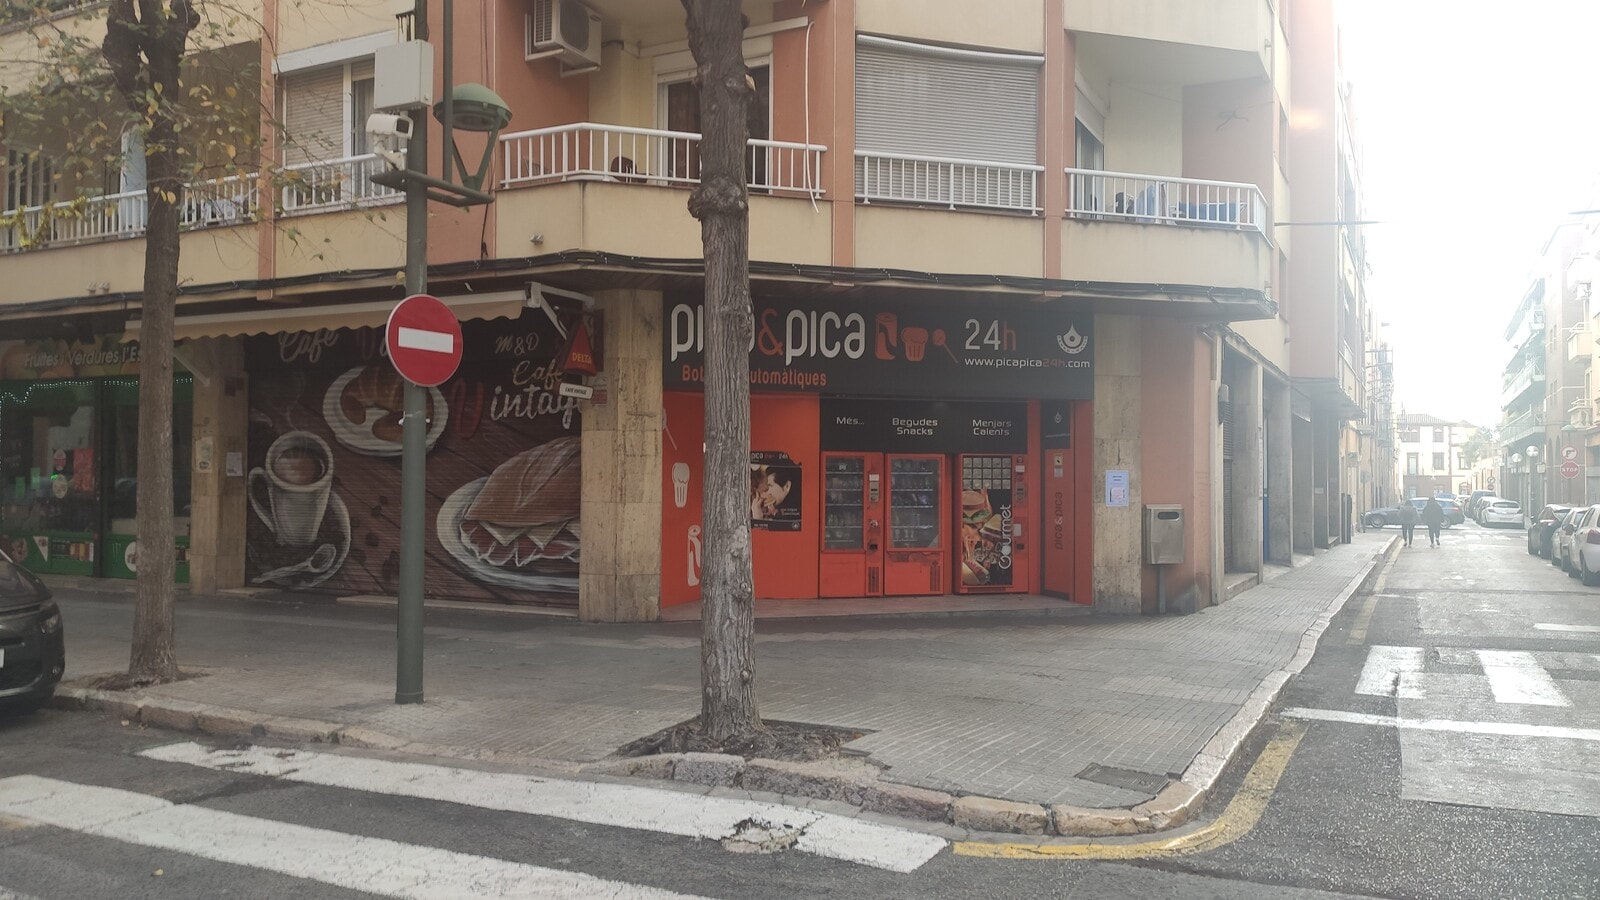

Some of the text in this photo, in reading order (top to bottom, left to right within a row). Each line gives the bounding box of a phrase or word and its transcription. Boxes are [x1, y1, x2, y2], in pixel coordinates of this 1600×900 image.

[671, 304, 866, 366] pi&pica
[965, 319, 1016, 350] 24h
[24, 352, 58, 367] Fruites
[68, 350, 119, 365] Verdures
[572, 352, 592, 364] DELTA
[965, 357, 1090, 369] www.picapica24h.com
[749, 368, 827, 389] utomàtiques
[892, 417, 938, 428] Begudes
[972, 419, 1012, 429] Menjars
[897, 427, 933, 435] Snacks
[973, 428, 1010, 436] Calents
[1054, 491, 1063, 550] pica&pica
[999, 504, 1011, 569] Gourmet
